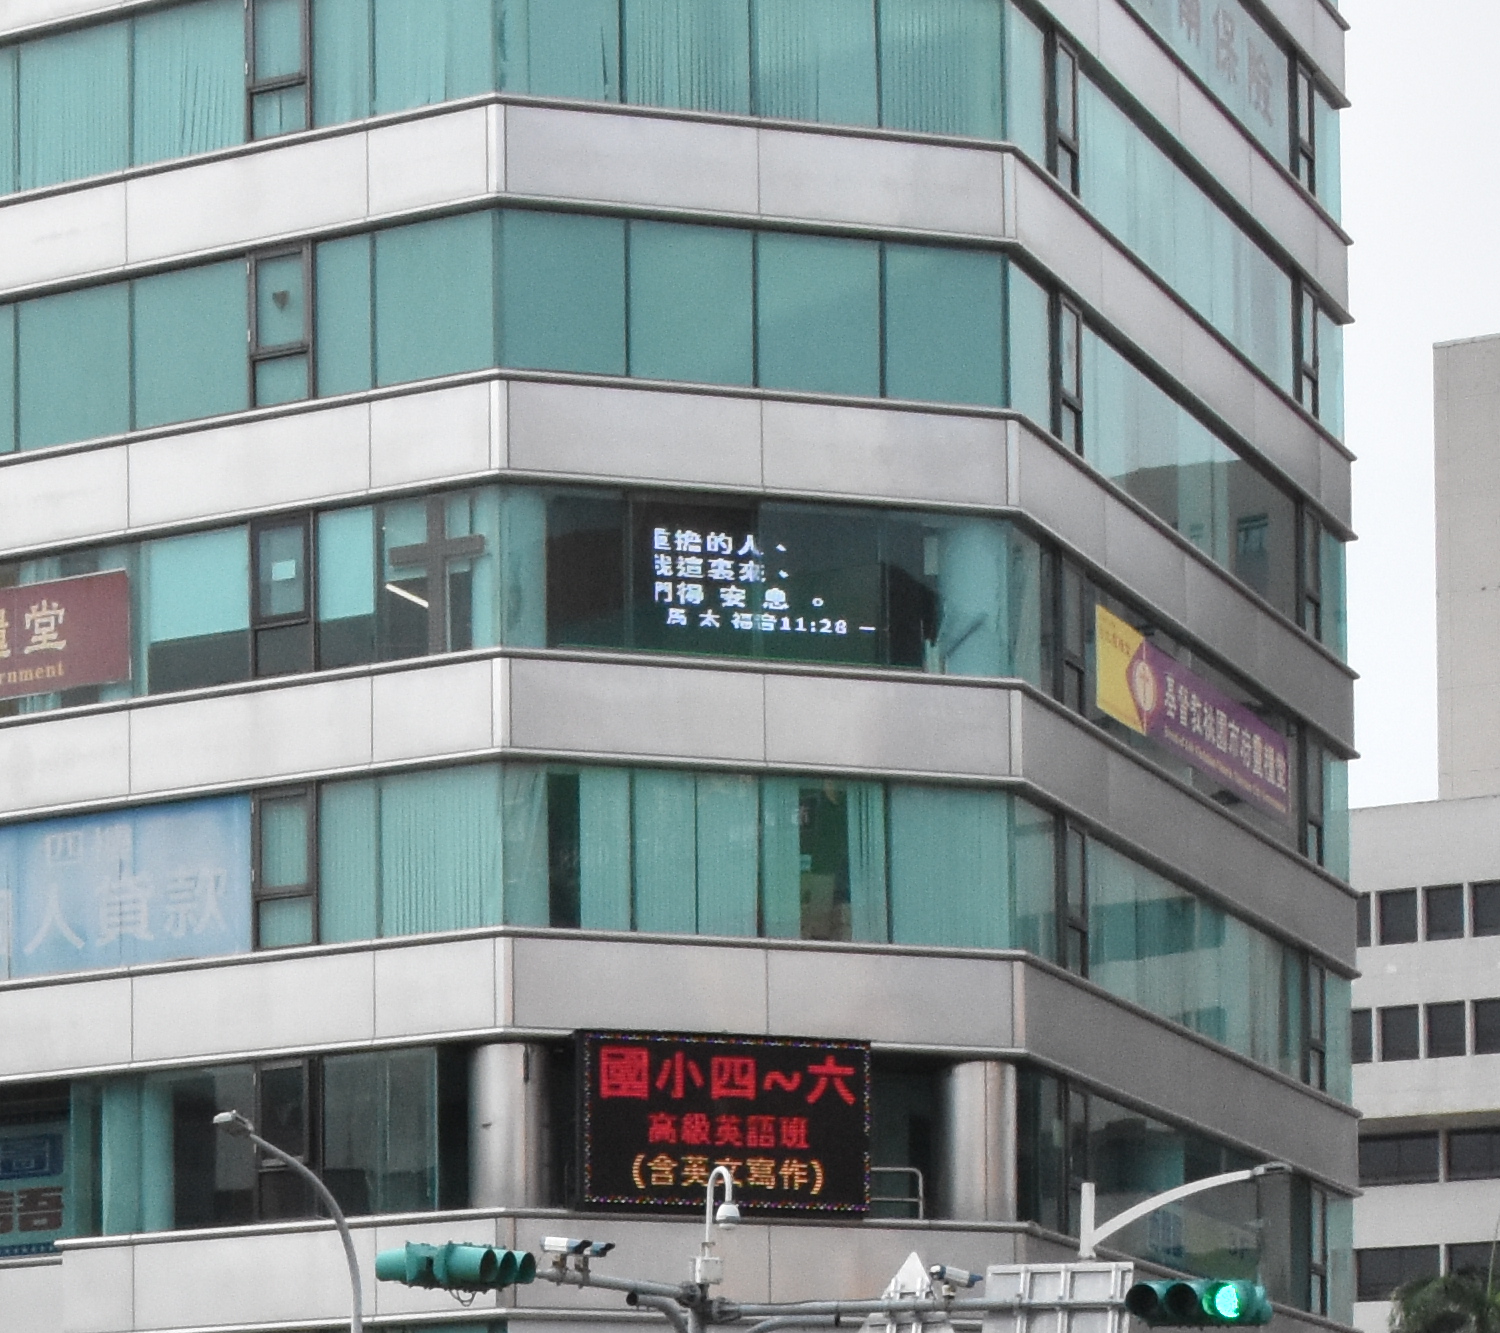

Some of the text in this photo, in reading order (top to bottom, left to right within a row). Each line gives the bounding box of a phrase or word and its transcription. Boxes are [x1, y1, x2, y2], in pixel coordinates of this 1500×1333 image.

[648, 1111, 811, 1150] 高級英語班
